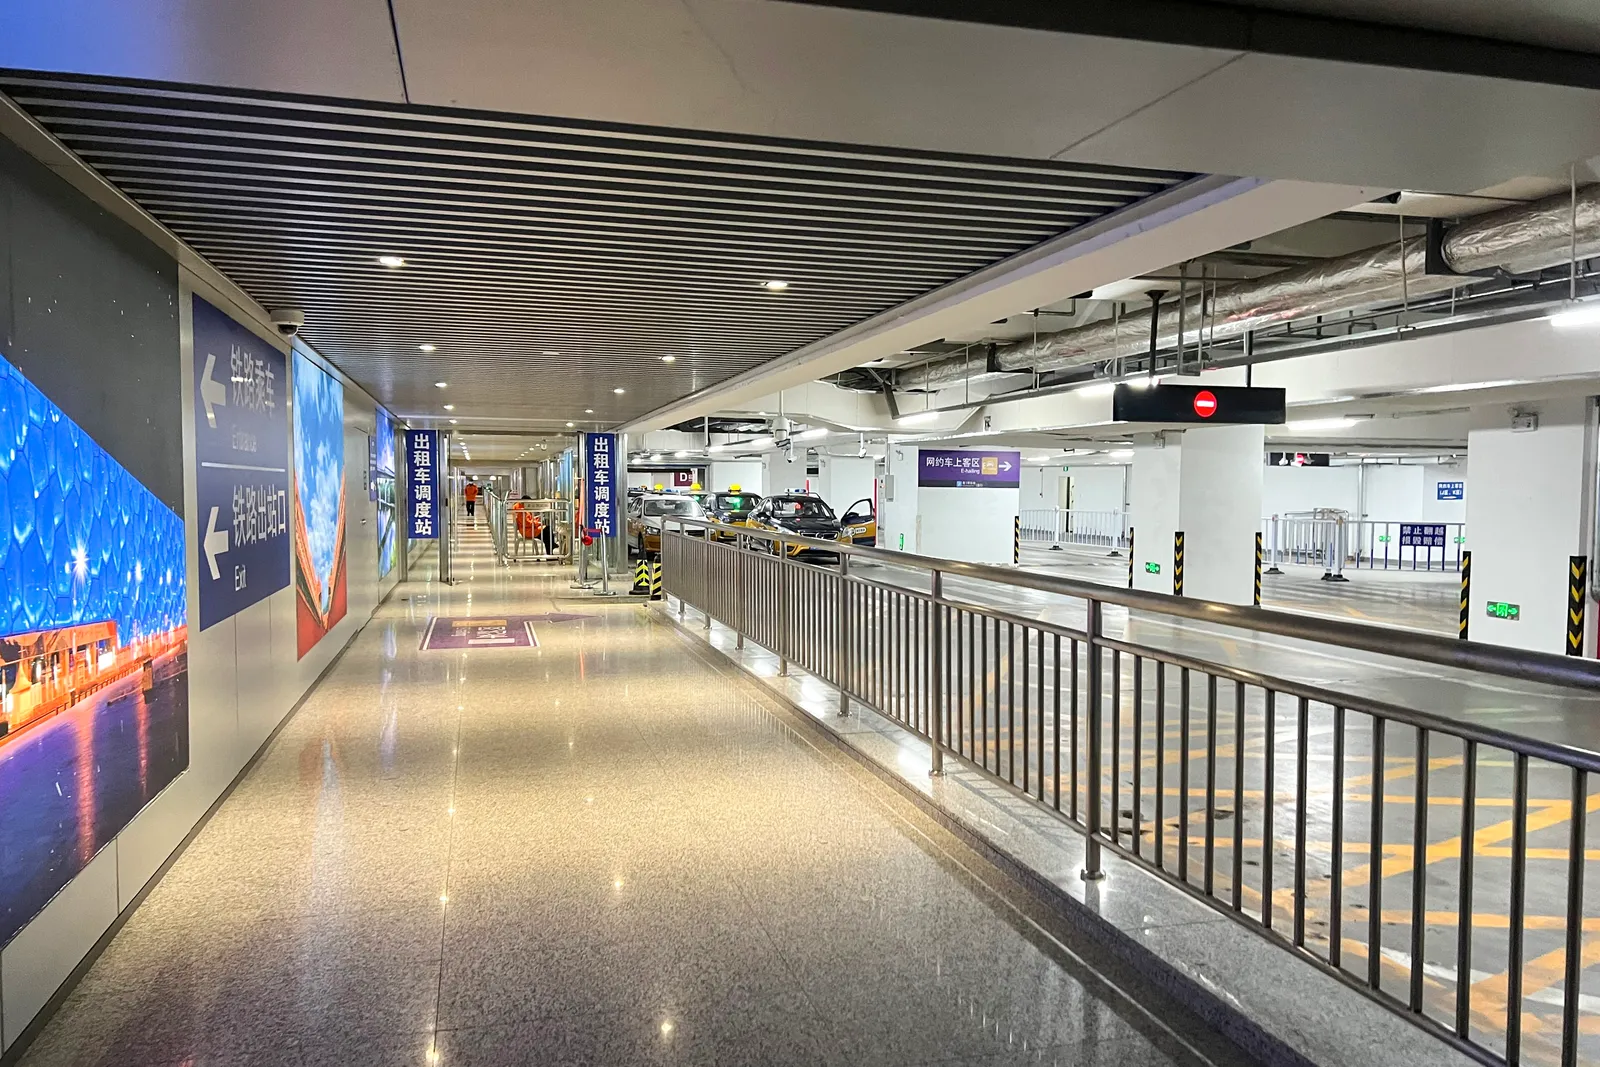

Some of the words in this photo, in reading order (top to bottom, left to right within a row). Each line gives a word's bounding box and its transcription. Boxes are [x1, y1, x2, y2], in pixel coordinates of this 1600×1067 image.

[231, 344, 275, 419] 铁路乘车
[232, 427, 257, 453] Entrance
[926, 456, 980, 468] 网约车上客区
[413, 433, 432, 536] 出租车调度站
[593, 437, 610, 534] 出租车调度站
[233, 483, 286, 548] 铁路出站口
[1402, 526, 1444, 535] 禁止翻越
[234, 564, 247, 592] Exit
